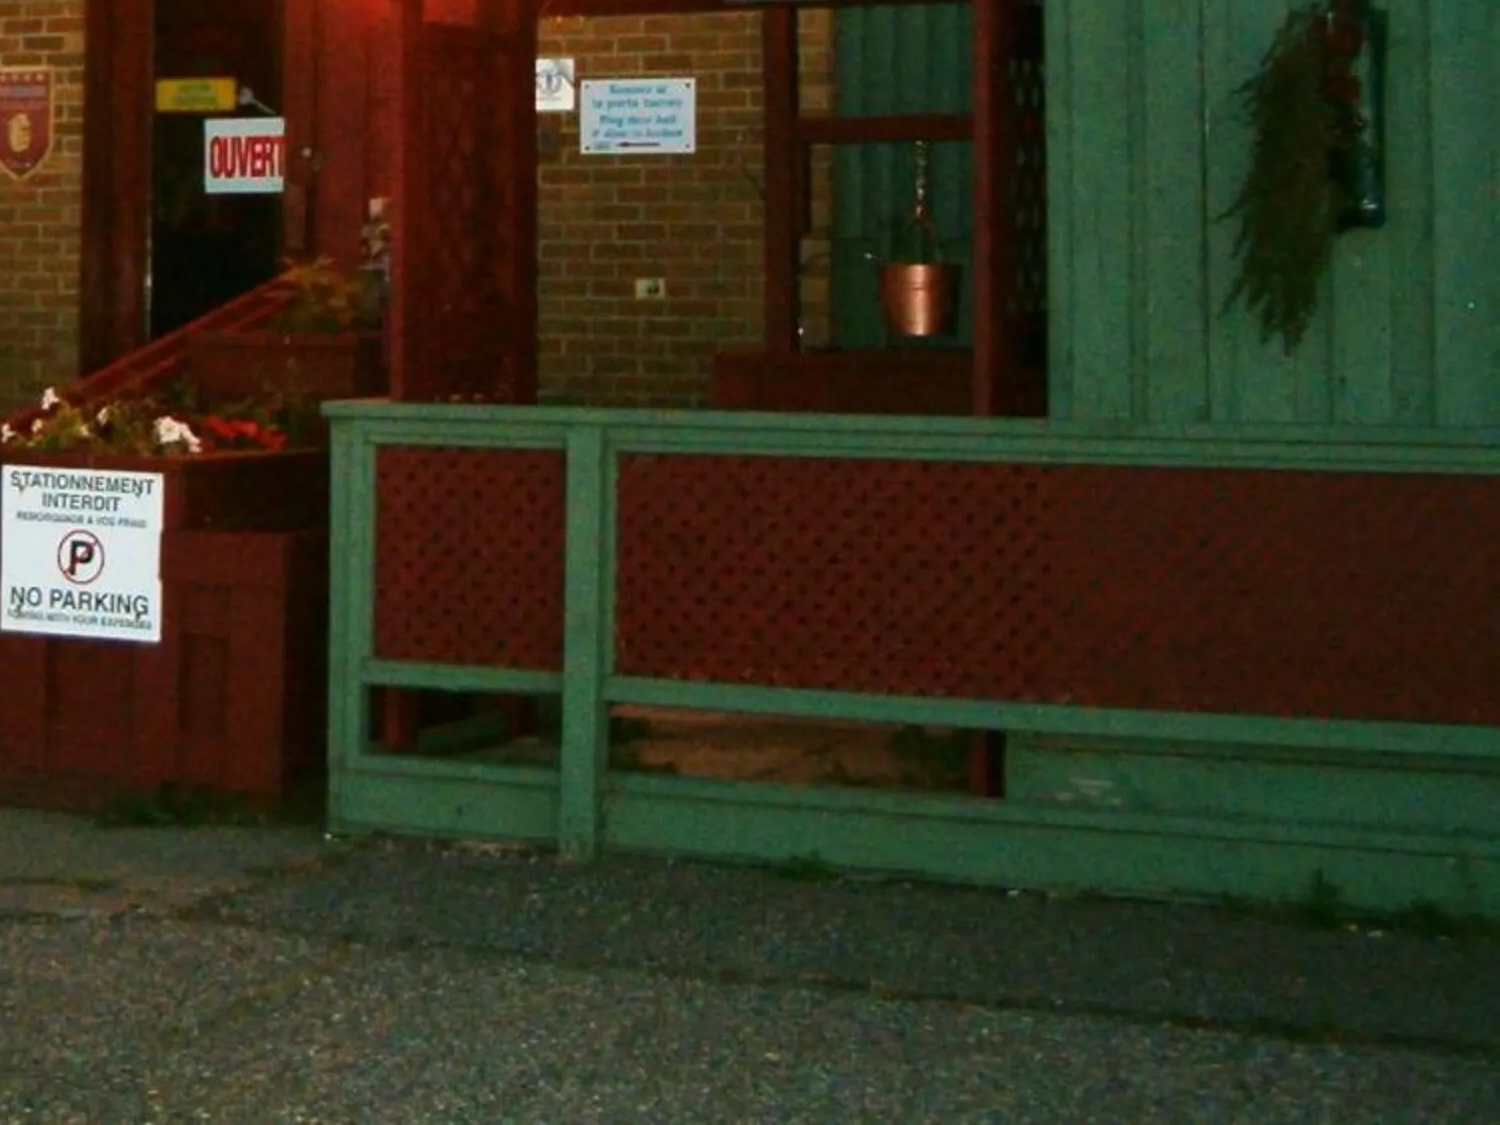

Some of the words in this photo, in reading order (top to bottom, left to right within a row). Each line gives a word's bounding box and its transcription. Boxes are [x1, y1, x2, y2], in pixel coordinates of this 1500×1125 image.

[210, 135, 287, 179] OUVERT
[10, 470, 156, 496] STATIONNEMENT
[41, 492, 122, 512] INTERDIT
[10, 586, 43, 607] NO
[49, 589, 150, 615] PARKING
